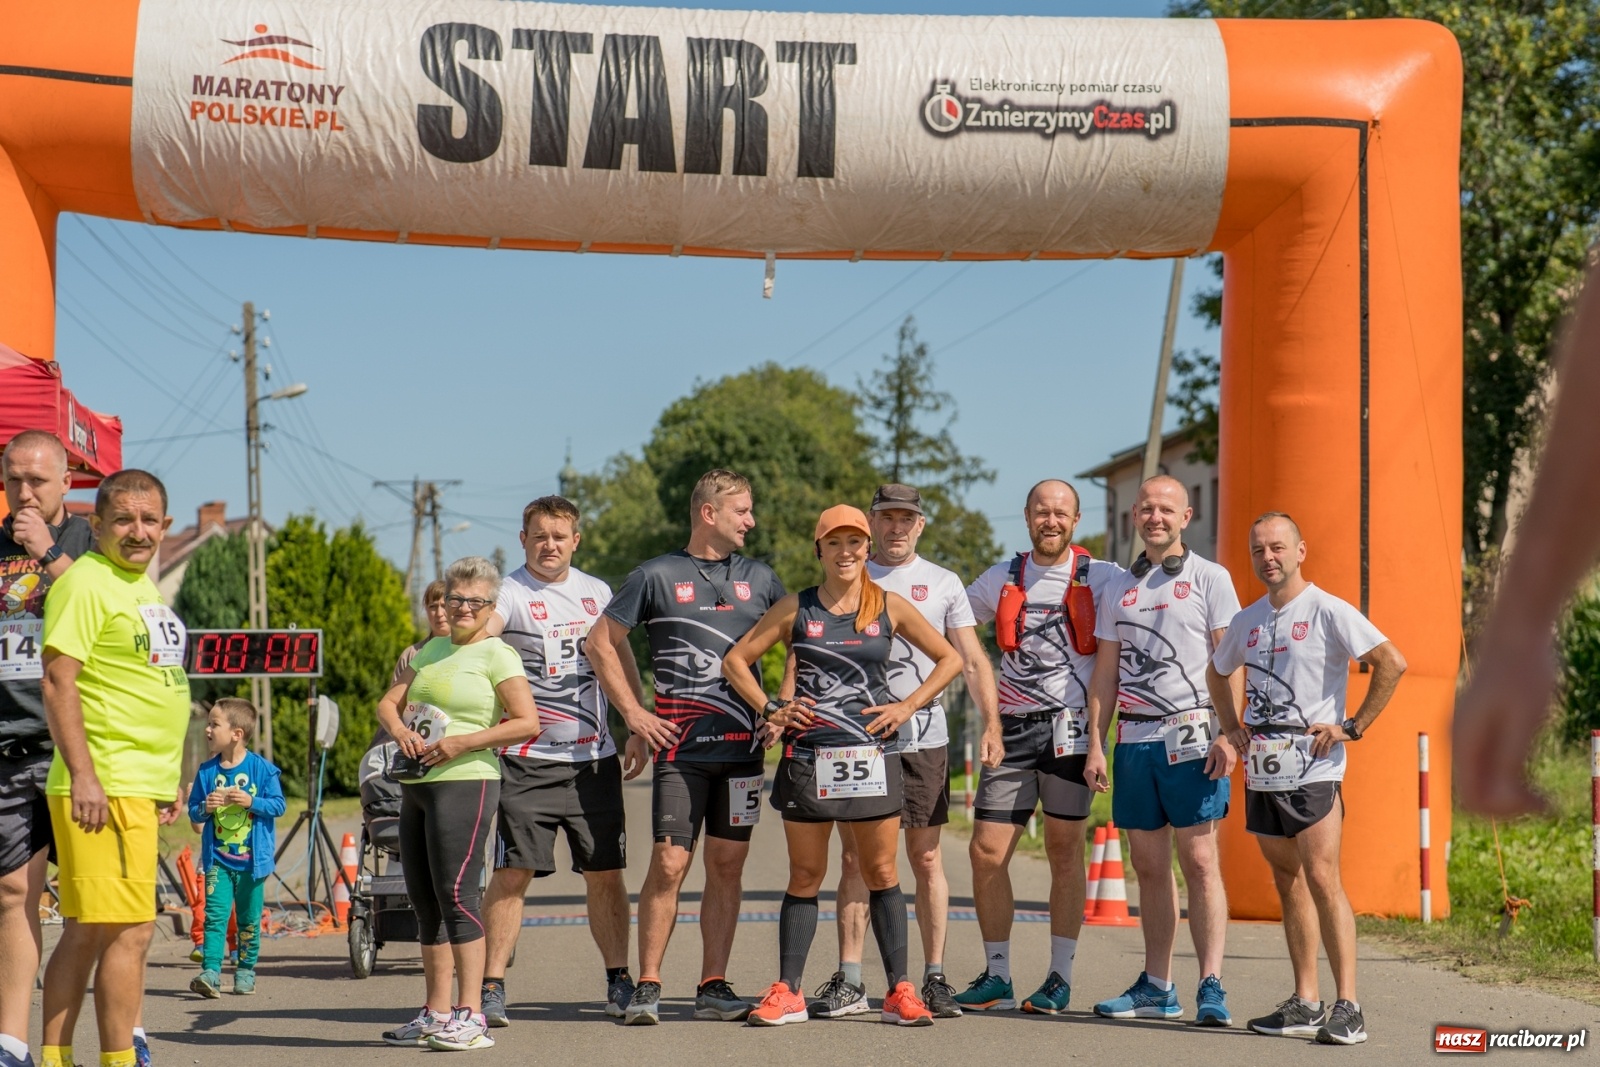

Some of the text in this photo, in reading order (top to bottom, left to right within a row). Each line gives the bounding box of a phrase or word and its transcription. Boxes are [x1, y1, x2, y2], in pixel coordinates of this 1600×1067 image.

[192, 74, 345, 106] MARATONY
[969, 78, 1162, 95] Elektroniczny pomiar czasu
[417, 22, 857, 178] START
[190, 100, 344, 131] POLSKIE.PL
[964, 103, 1172, 135] ZmierzymyCzas.pl
[28, 623, 42, 633] RU
[158, 621, 181, 647] 15
[547, 627, 581, 639] COLOUR
[0, 635, 37, 661] 14
[134, 633, 150, 654] PO
[1167, 712, 1201, 727] COLOUR
[1178, 721, 1212, 746] 21
[820, 749, 879, 760] COLOUR RUN
[1251, 742, 1267, 753] OUR
[832, 760, 870, 782] 35
[1250, 753, 1281, 775] 16
[745, 789, 760, 811] 5
